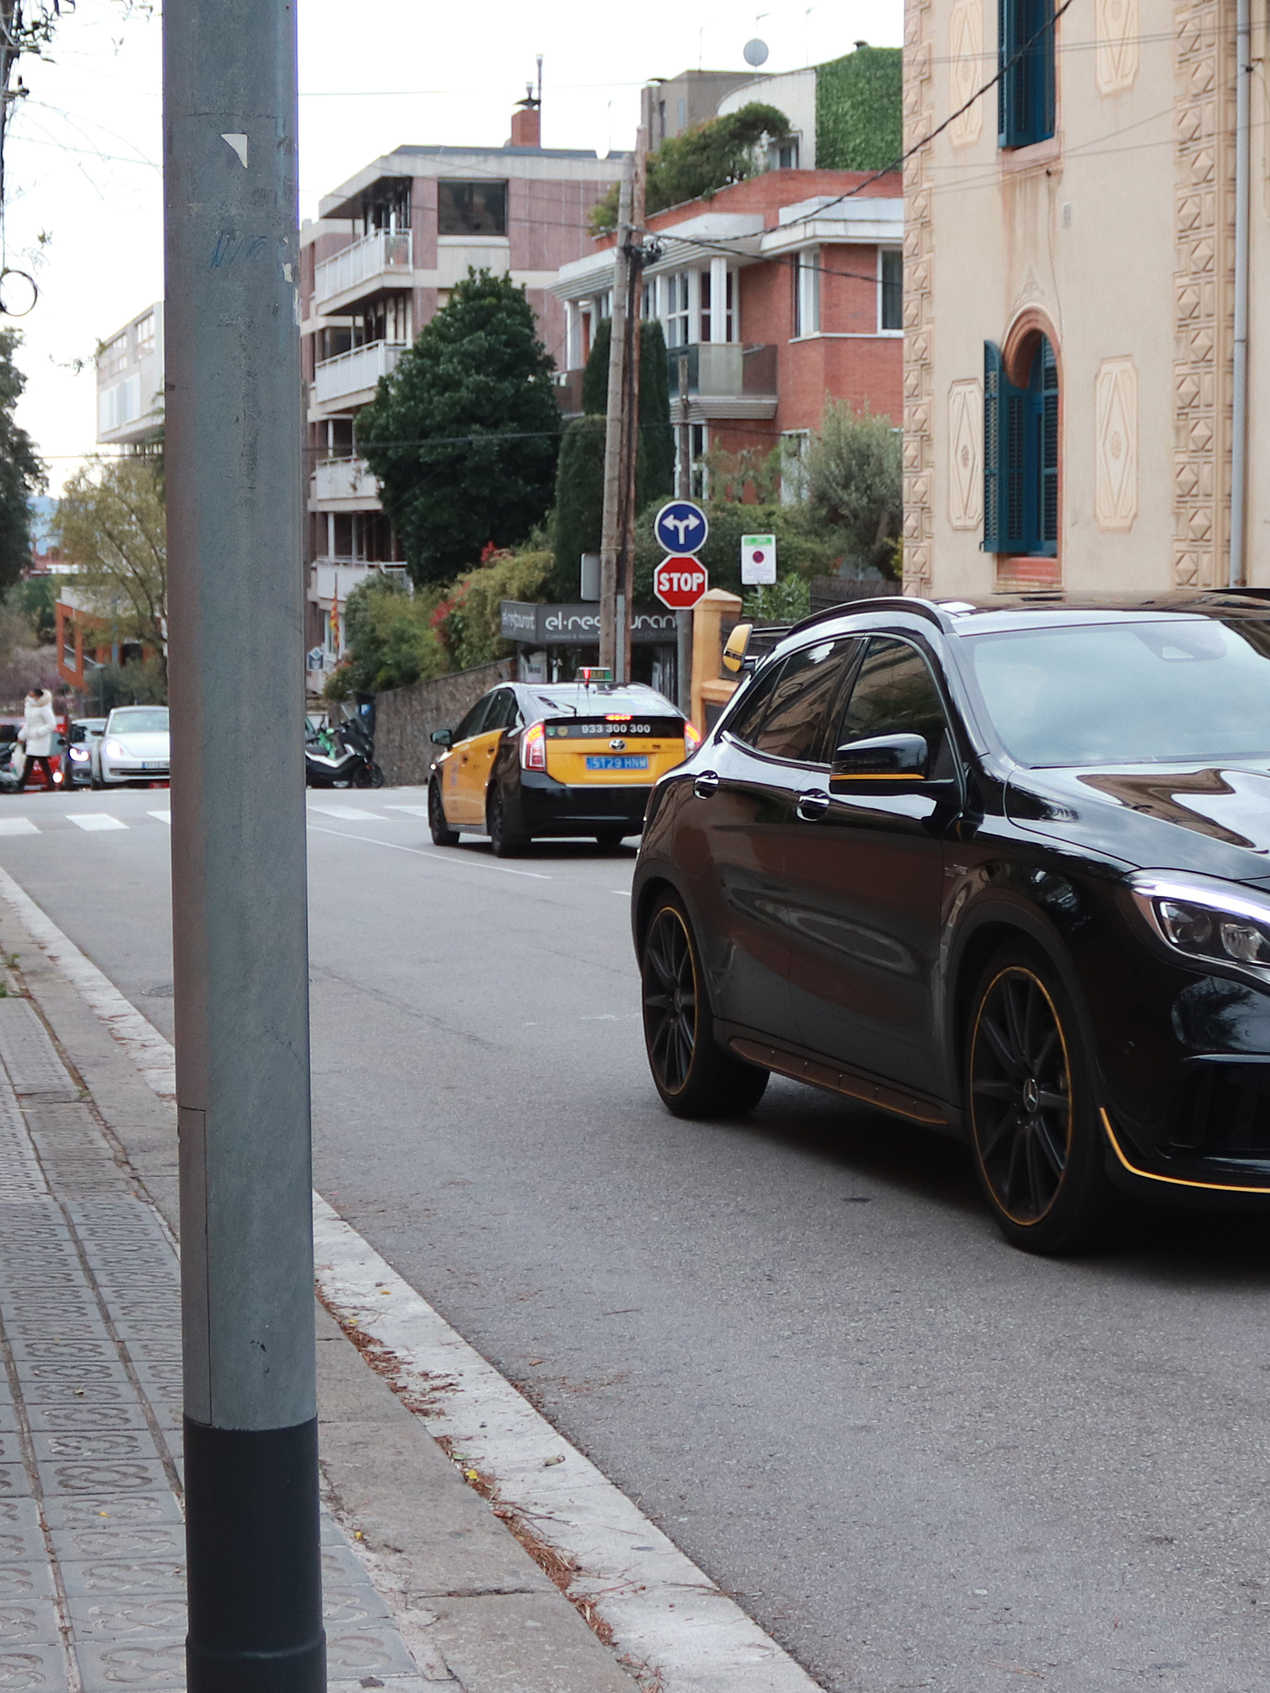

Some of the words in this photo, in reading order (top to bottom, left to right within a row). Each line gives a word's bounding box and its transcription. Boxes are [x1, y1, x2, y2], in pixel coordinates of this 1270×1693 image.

[659, 572, 704, 592] STOP
[581, 724, 603, 734] 933
[606, 724, 627, 733] 300
[630, 724, 651, 733] 300
[592, 758, 622, 769] 5129
